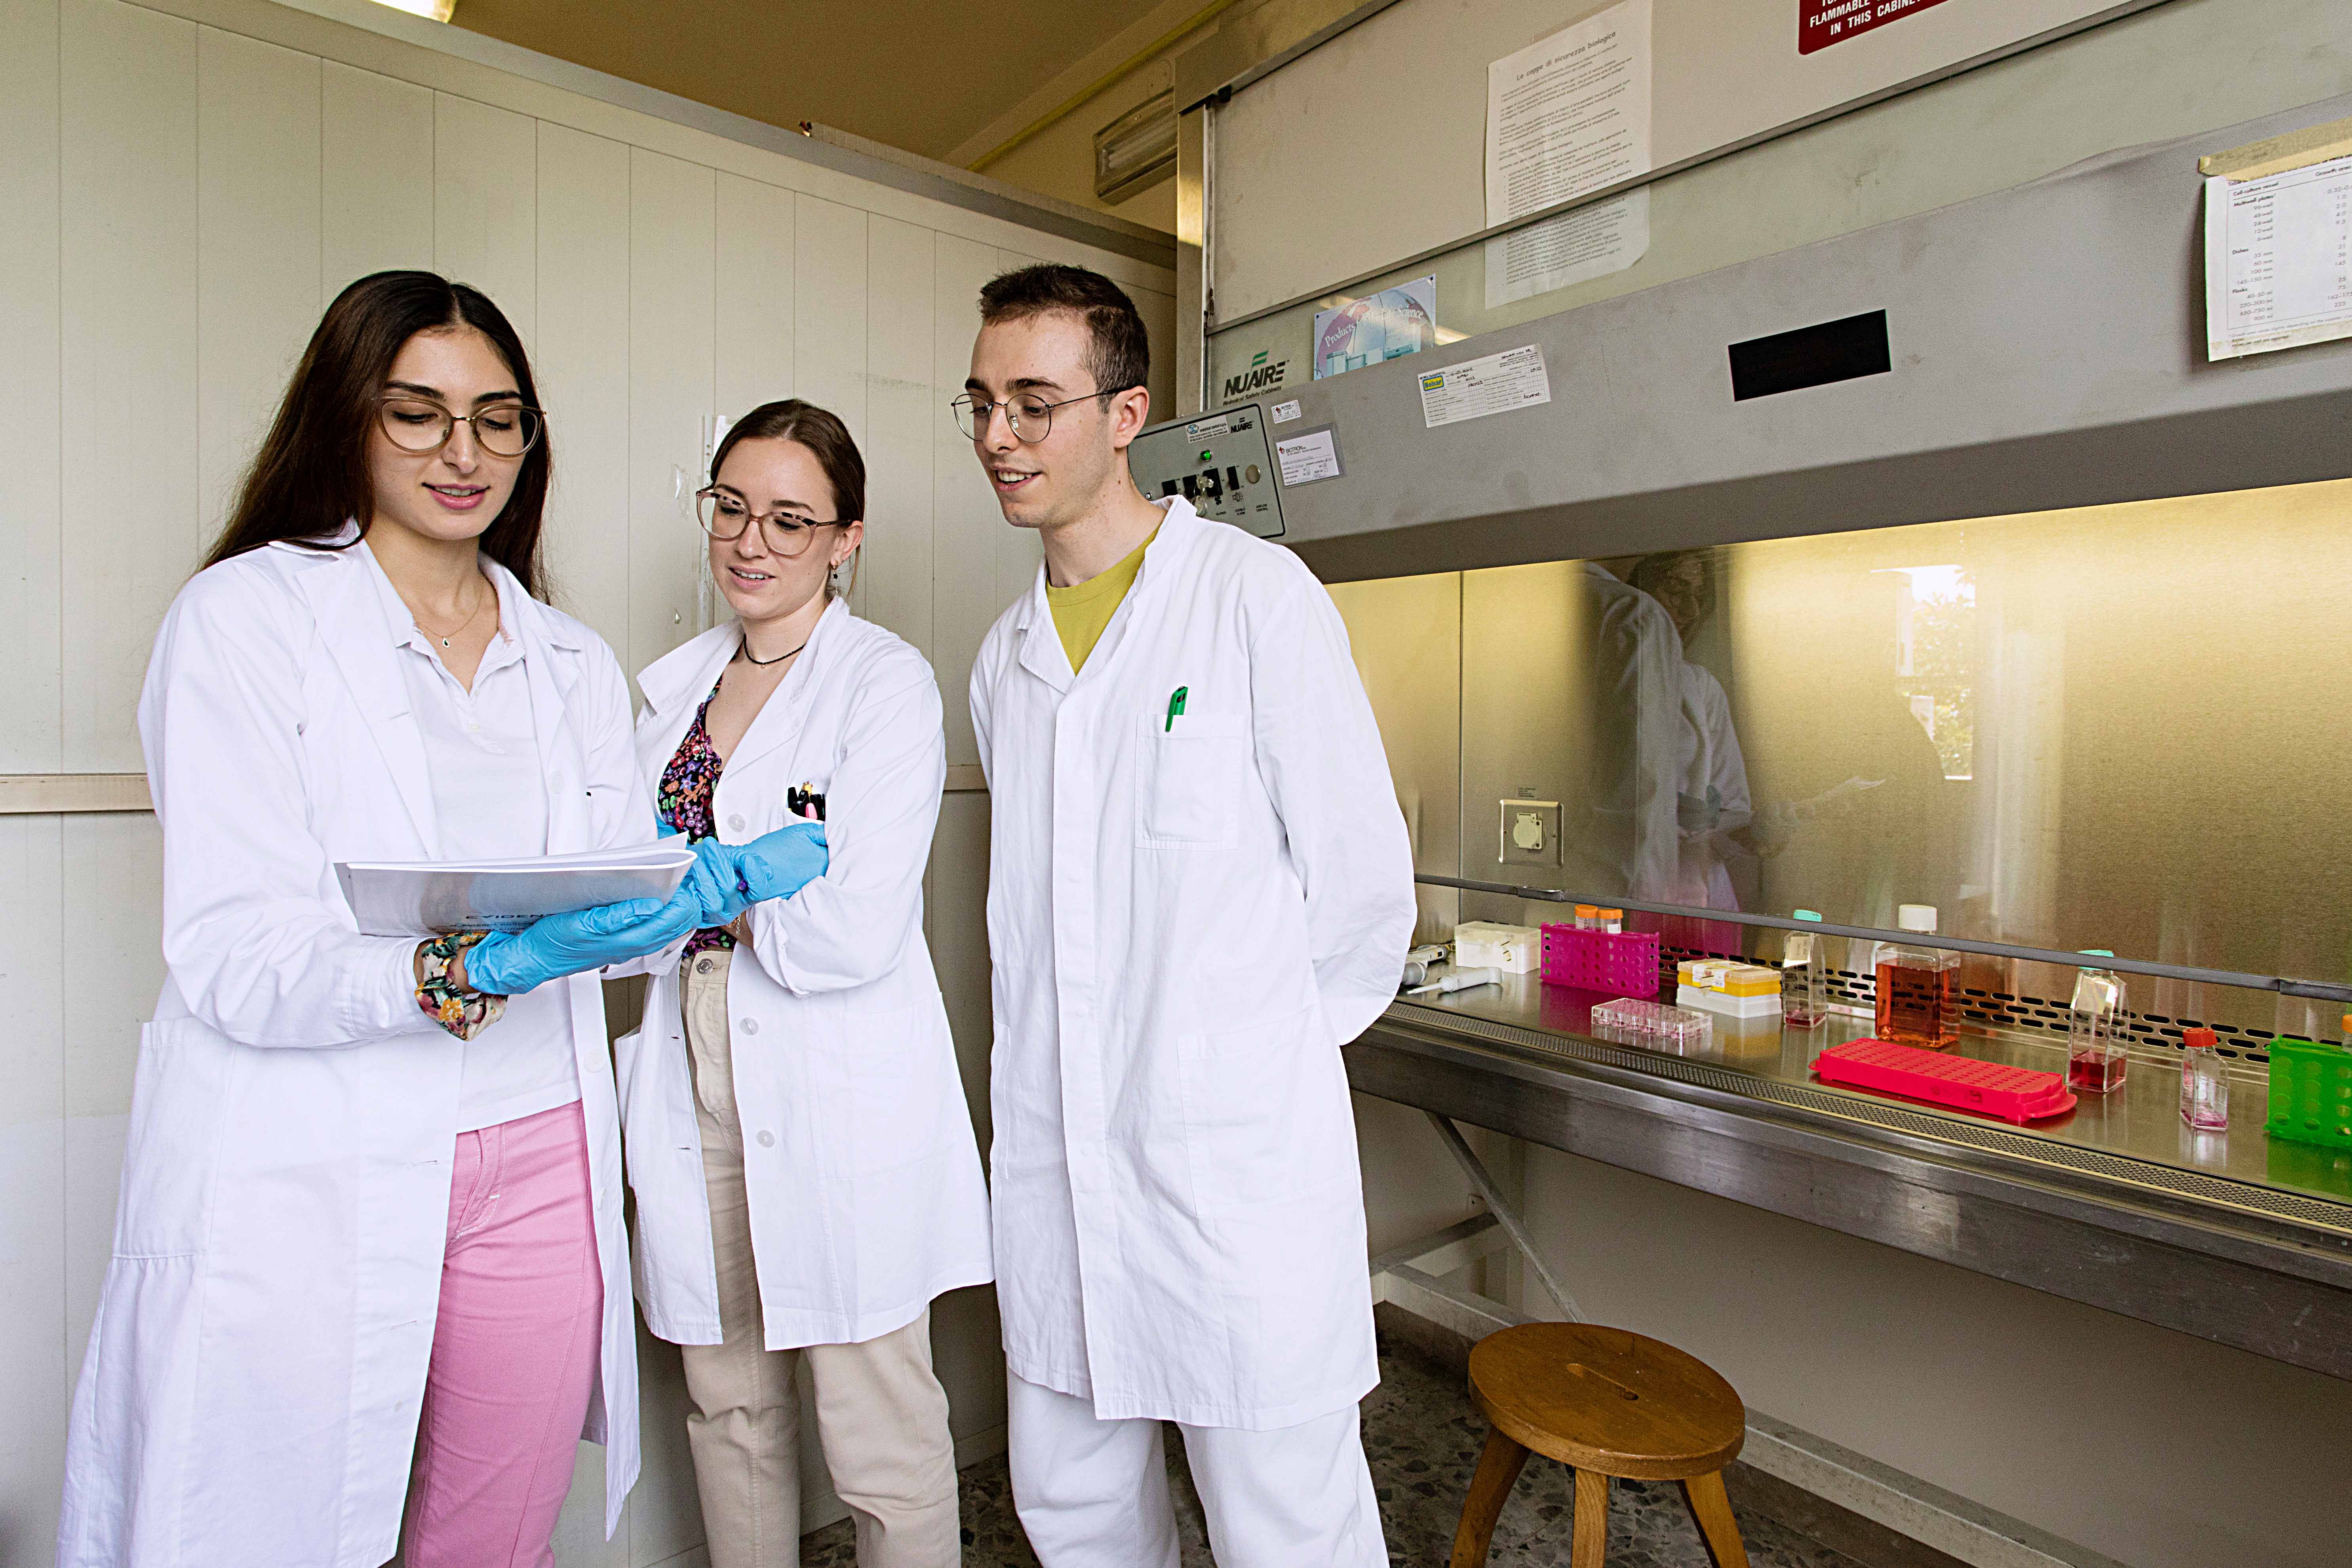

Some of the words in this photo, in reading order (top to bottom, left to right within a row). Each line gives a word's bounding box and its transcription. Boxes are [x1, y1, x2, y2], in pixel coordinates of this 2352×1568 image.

[1810, 0, 1870, 28] FLAMMABLE
[1830, 22, 1841, 36] IN
[1847, 10, 1871, 28] THIS
[1877, 0, 1920, 17] CABIN
[1517, 72, 1524, 81] Le
[1555, 46, 1585, 63] sicurezza
[1588, 31, 1616, 49] biologica
[1325, 324, 1355, 347] Products
[1398, 304, 1423, 319] Science
[1224, 361, 1286, 398] NUAIRE
[1262, 386, 1281, 395] Cabinets
[1231, 421, 1252, 433] NUAIRE
